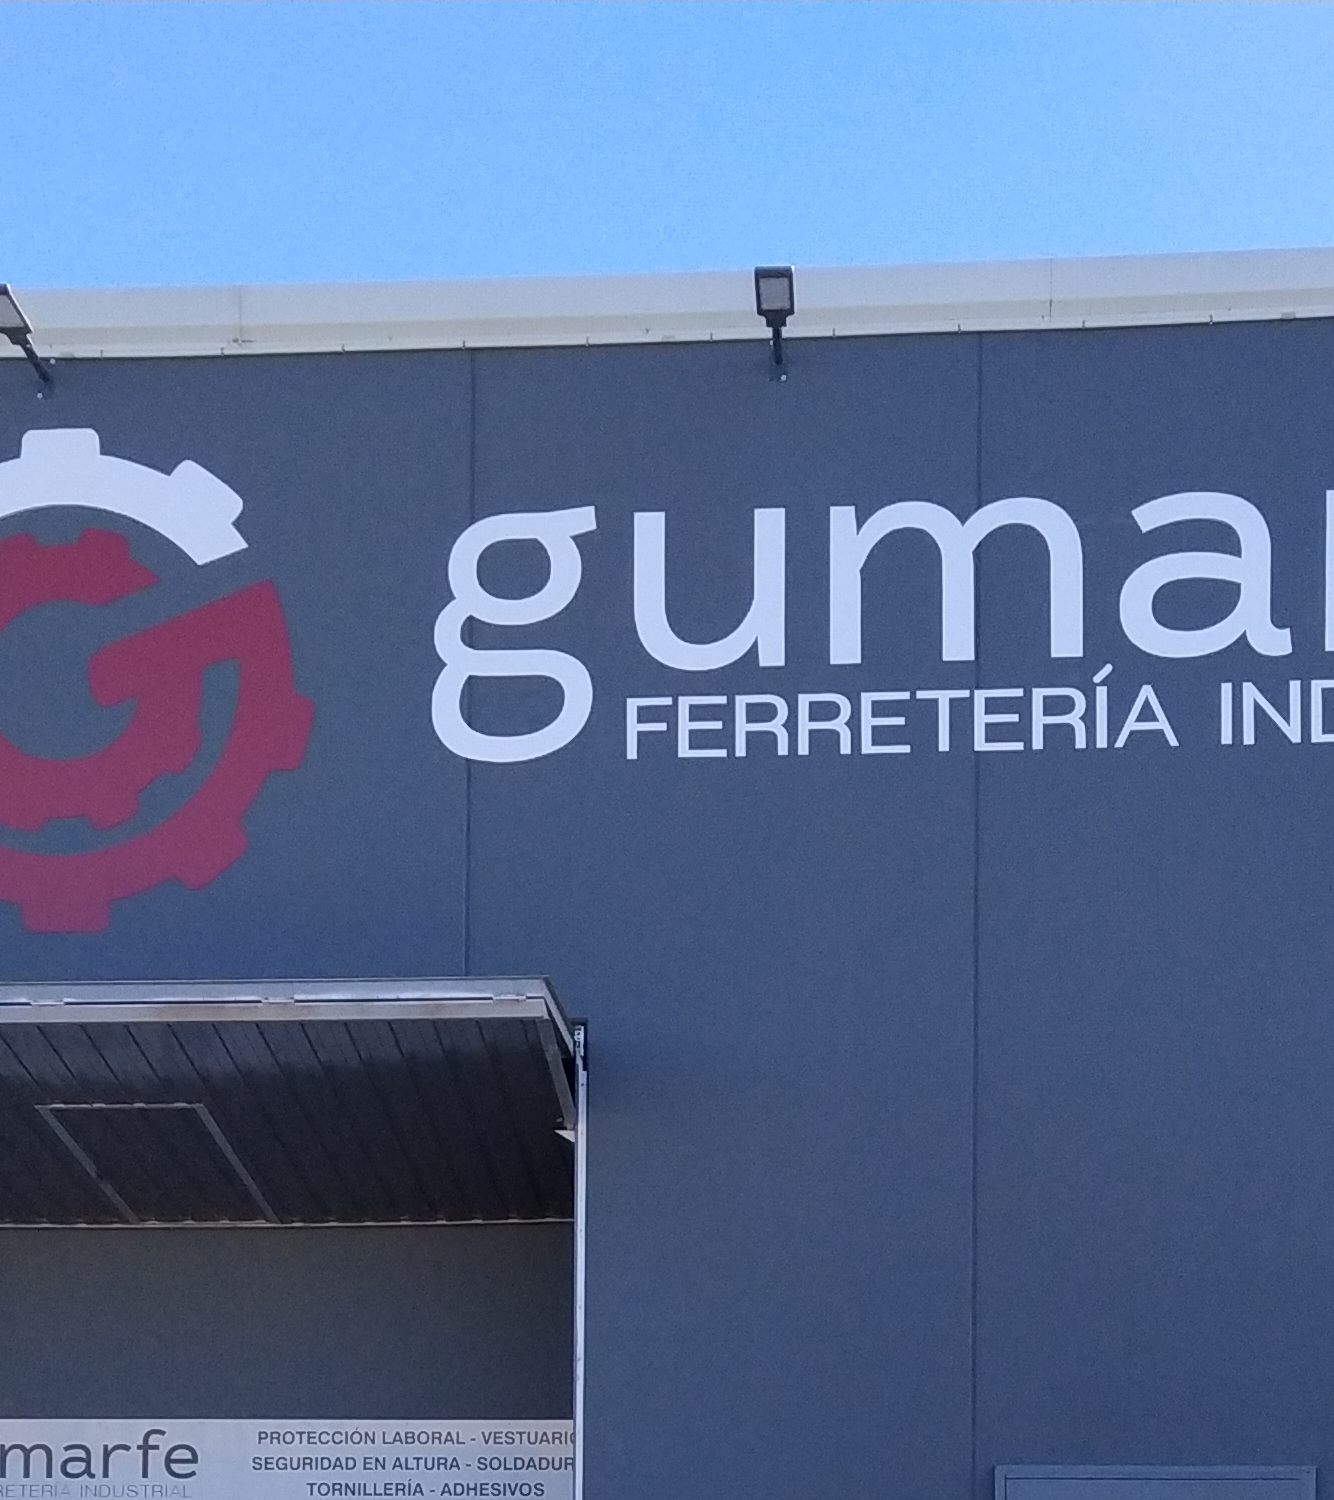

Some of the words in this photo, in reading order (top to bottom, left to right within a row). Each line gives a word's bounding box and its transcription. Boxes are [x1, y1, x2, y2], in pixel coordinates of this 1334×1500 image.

[624, 664, 1181, 760] FERRETERÍA
[257, 1426, 376, 1446] PROTECCIÓN
[382, 1431, 466, 1445] LABORAL
[251, 1456, 357, 1471] SEGURIDAD
[363, 1456, 386, 1471] EN
[392, 1456, 461, 1471] ALTURA
[80, 1484, 192, 1498] INDUSTRIAL
[306, 1478, 424, 1497] TORNILLERÍA
[440, 1482, 545, 1497] ADHESIVOS
